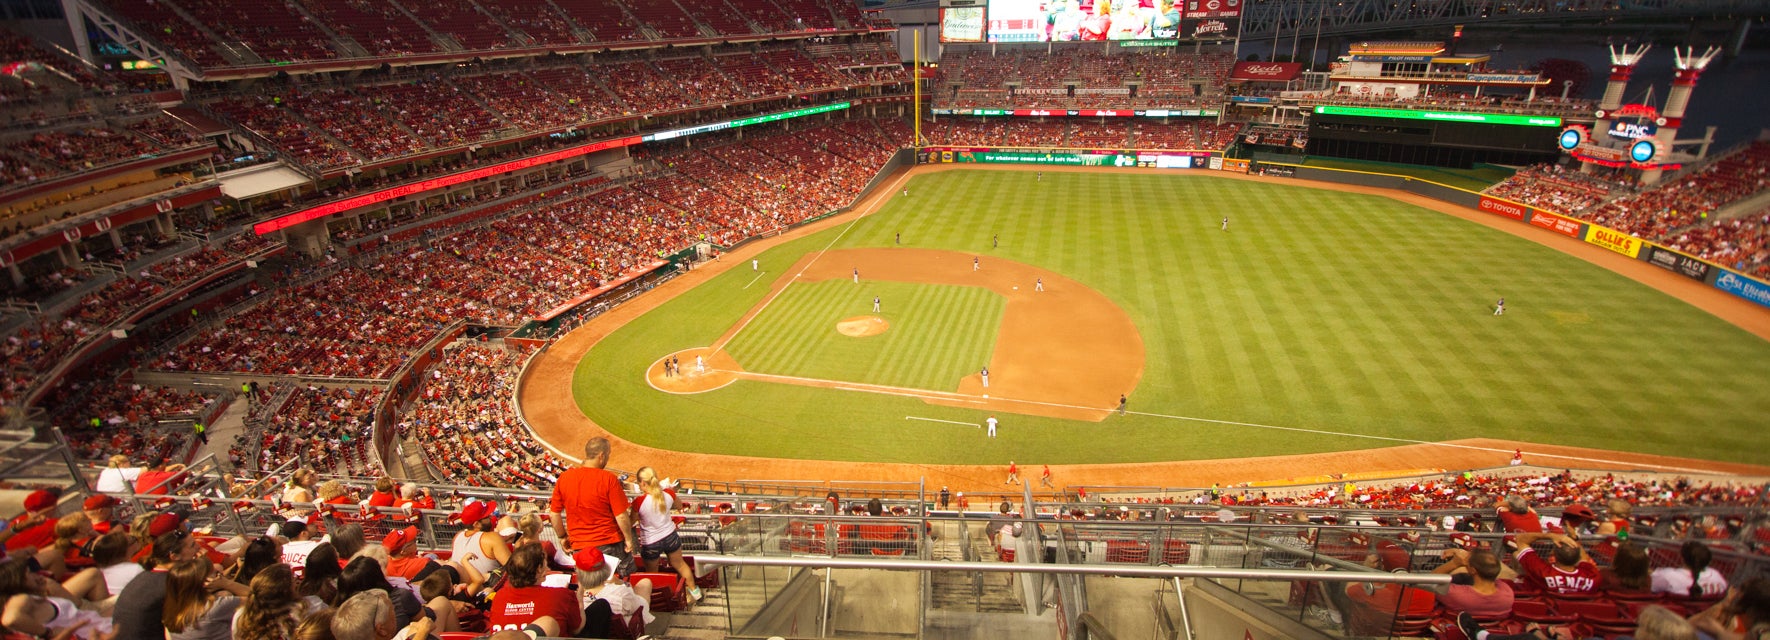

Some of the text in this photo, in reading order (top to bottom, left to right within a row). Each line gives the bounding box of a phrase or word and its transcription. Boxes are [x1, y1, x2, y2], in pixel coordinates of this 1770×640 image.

[1194, 22, 1225, 35] Morrell
[1244, 64, 1282, 74] Reds
[1468, 74, 1537, 82] Cincinnati Bell
[1625, 123, 1649, 137] PNC
[374, 192, 391, 202] FOR
[1493, 202, 1521, 216] TOYOTA
[1592, 239, 1631, 254] BARGAIN OUTLET
[1681, 257, 1706, 273] JACK
[281, 553, 306, 564] RUCE
[1545, 576, 1594, 591] BENCH
